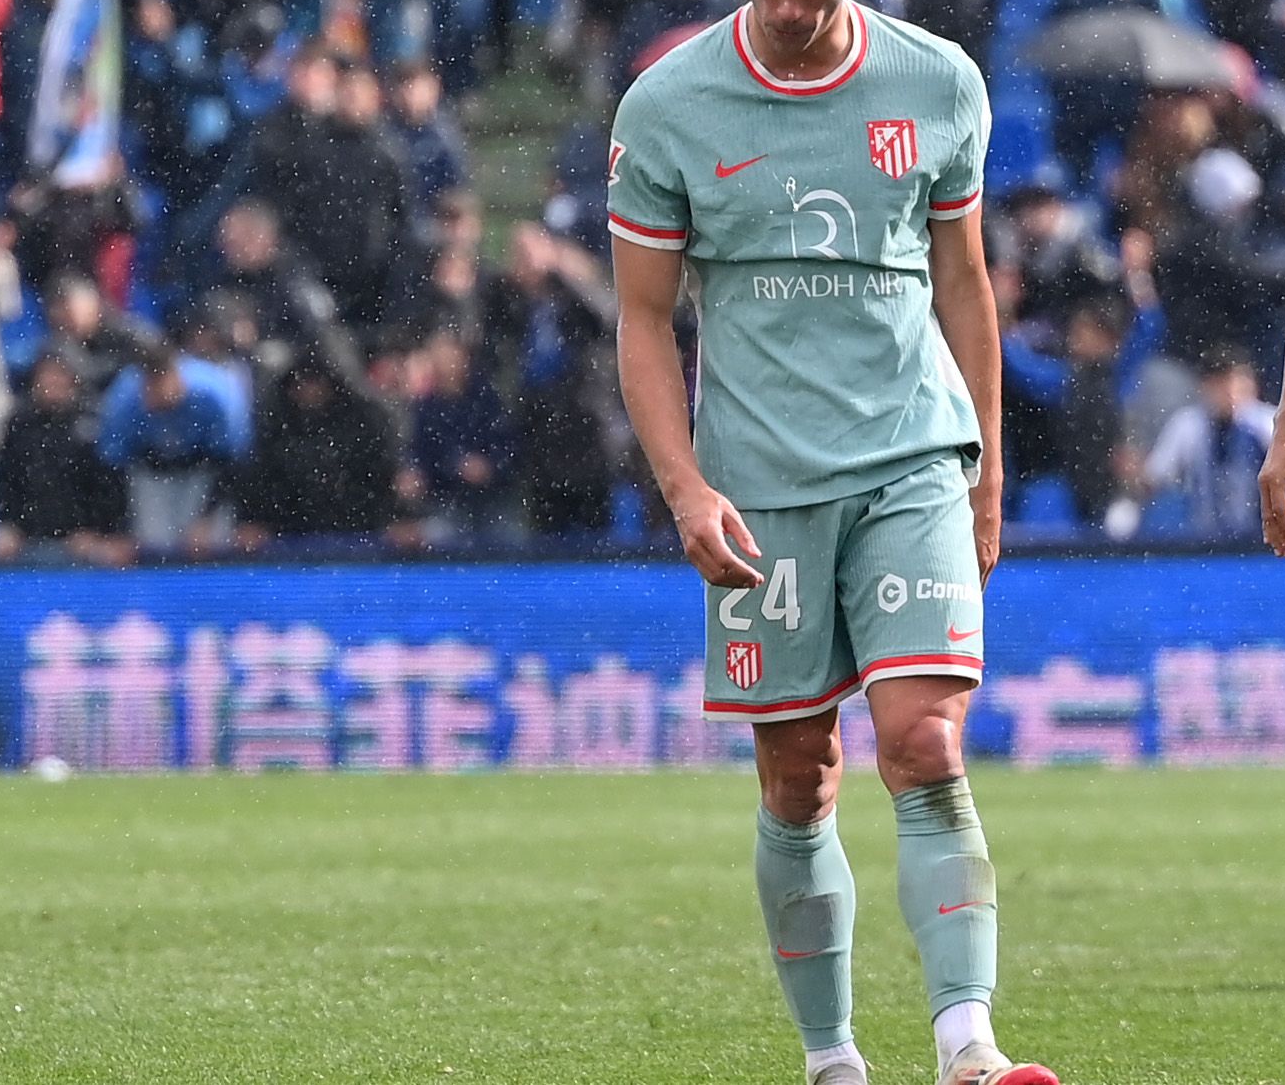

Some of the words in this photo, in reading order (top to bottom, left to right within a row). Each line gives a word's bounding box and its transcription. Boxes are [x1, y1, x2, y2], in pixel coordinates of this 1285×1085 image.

[753, 274, 854, 299] RIYADH
[863, 271, 903, 295] AIR
[719, 558, 800, 631] 24
